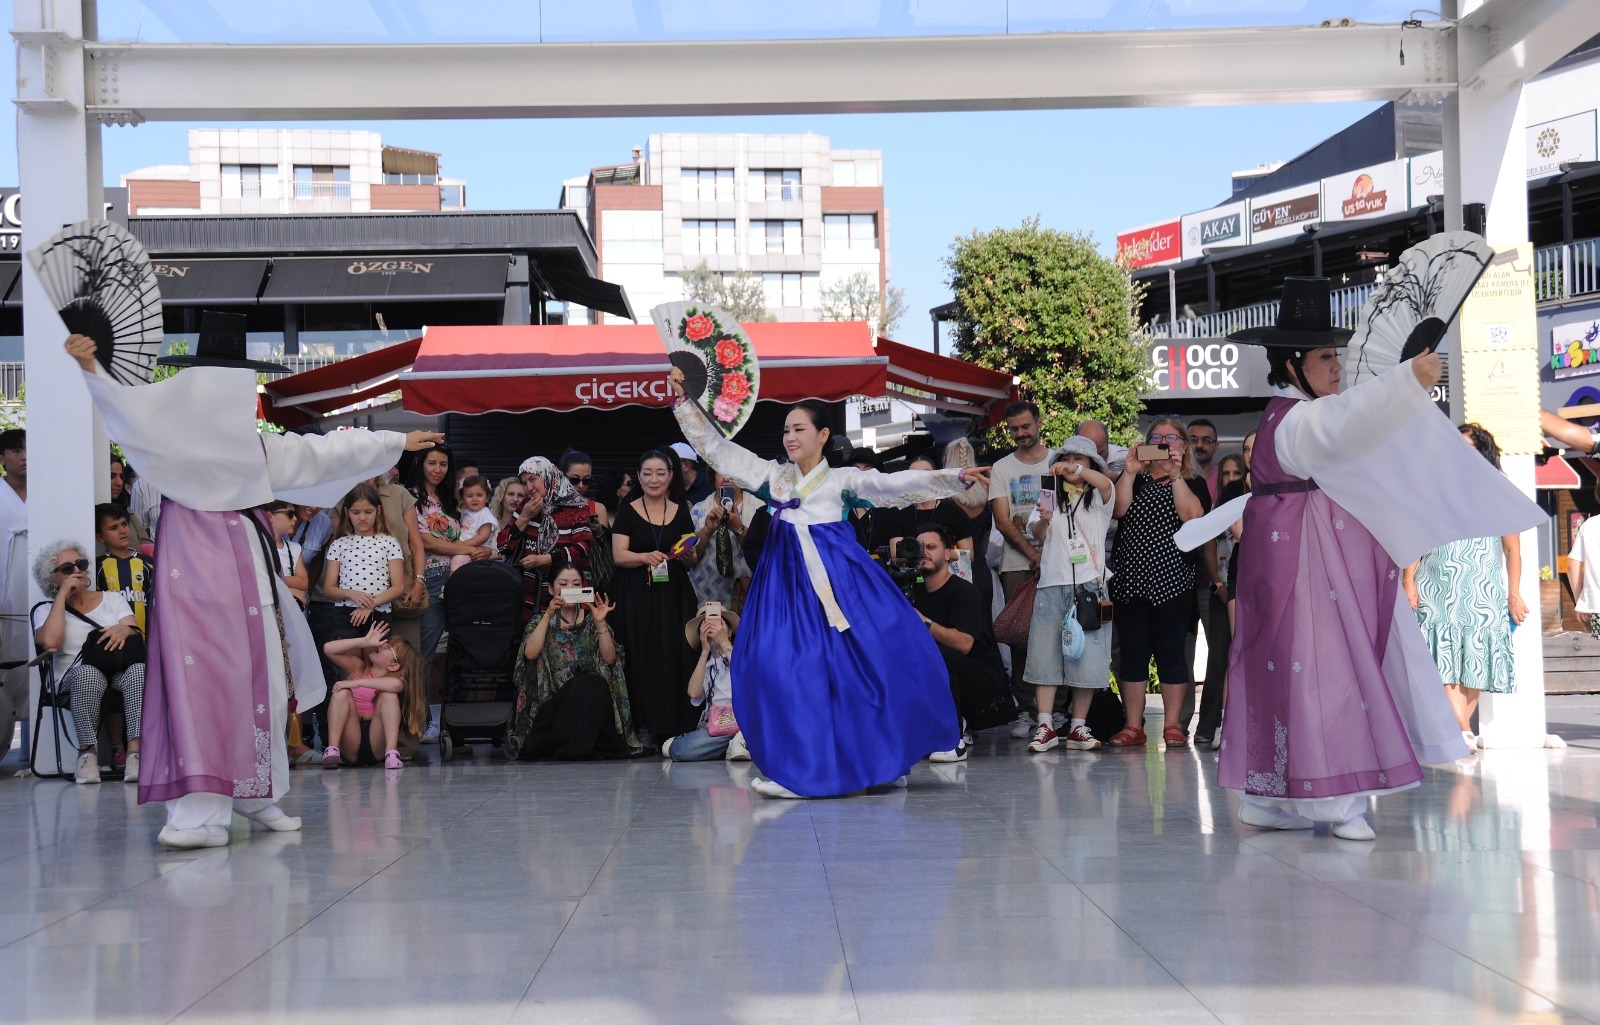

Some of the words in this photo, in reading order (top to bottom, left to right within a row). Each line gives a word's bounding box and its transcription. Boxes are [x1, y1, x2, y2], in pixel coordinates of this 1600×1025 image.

[1253, 205, 1289, 225] GÜVEN
[1203, 217, 1235, 239] AKAY
[347, 261, 434, 275] ÖZGEN
[1152, 344, 1239, 367] CHOCO
